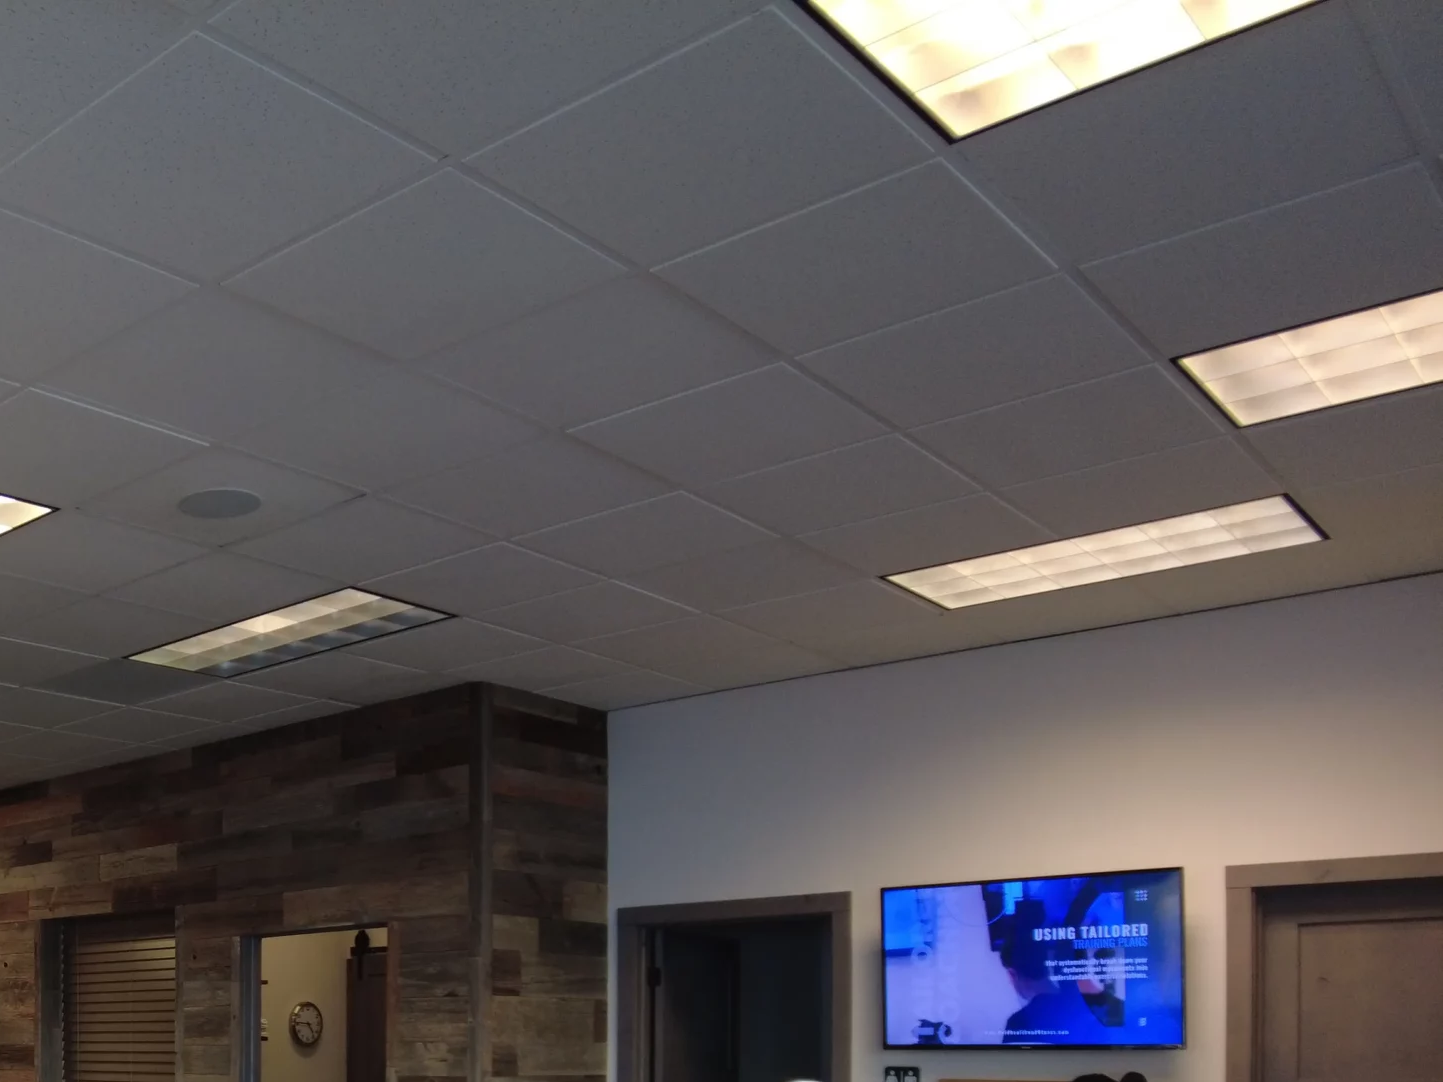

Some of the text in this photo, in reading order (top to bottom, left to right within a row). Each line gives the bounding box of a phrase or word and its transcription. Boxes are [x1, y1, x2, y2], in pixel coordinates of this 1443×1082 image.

[1033, 923, 1149, 941] USING TAILORED
[1073, 937, 1148, 950] TRAINING PLANS
